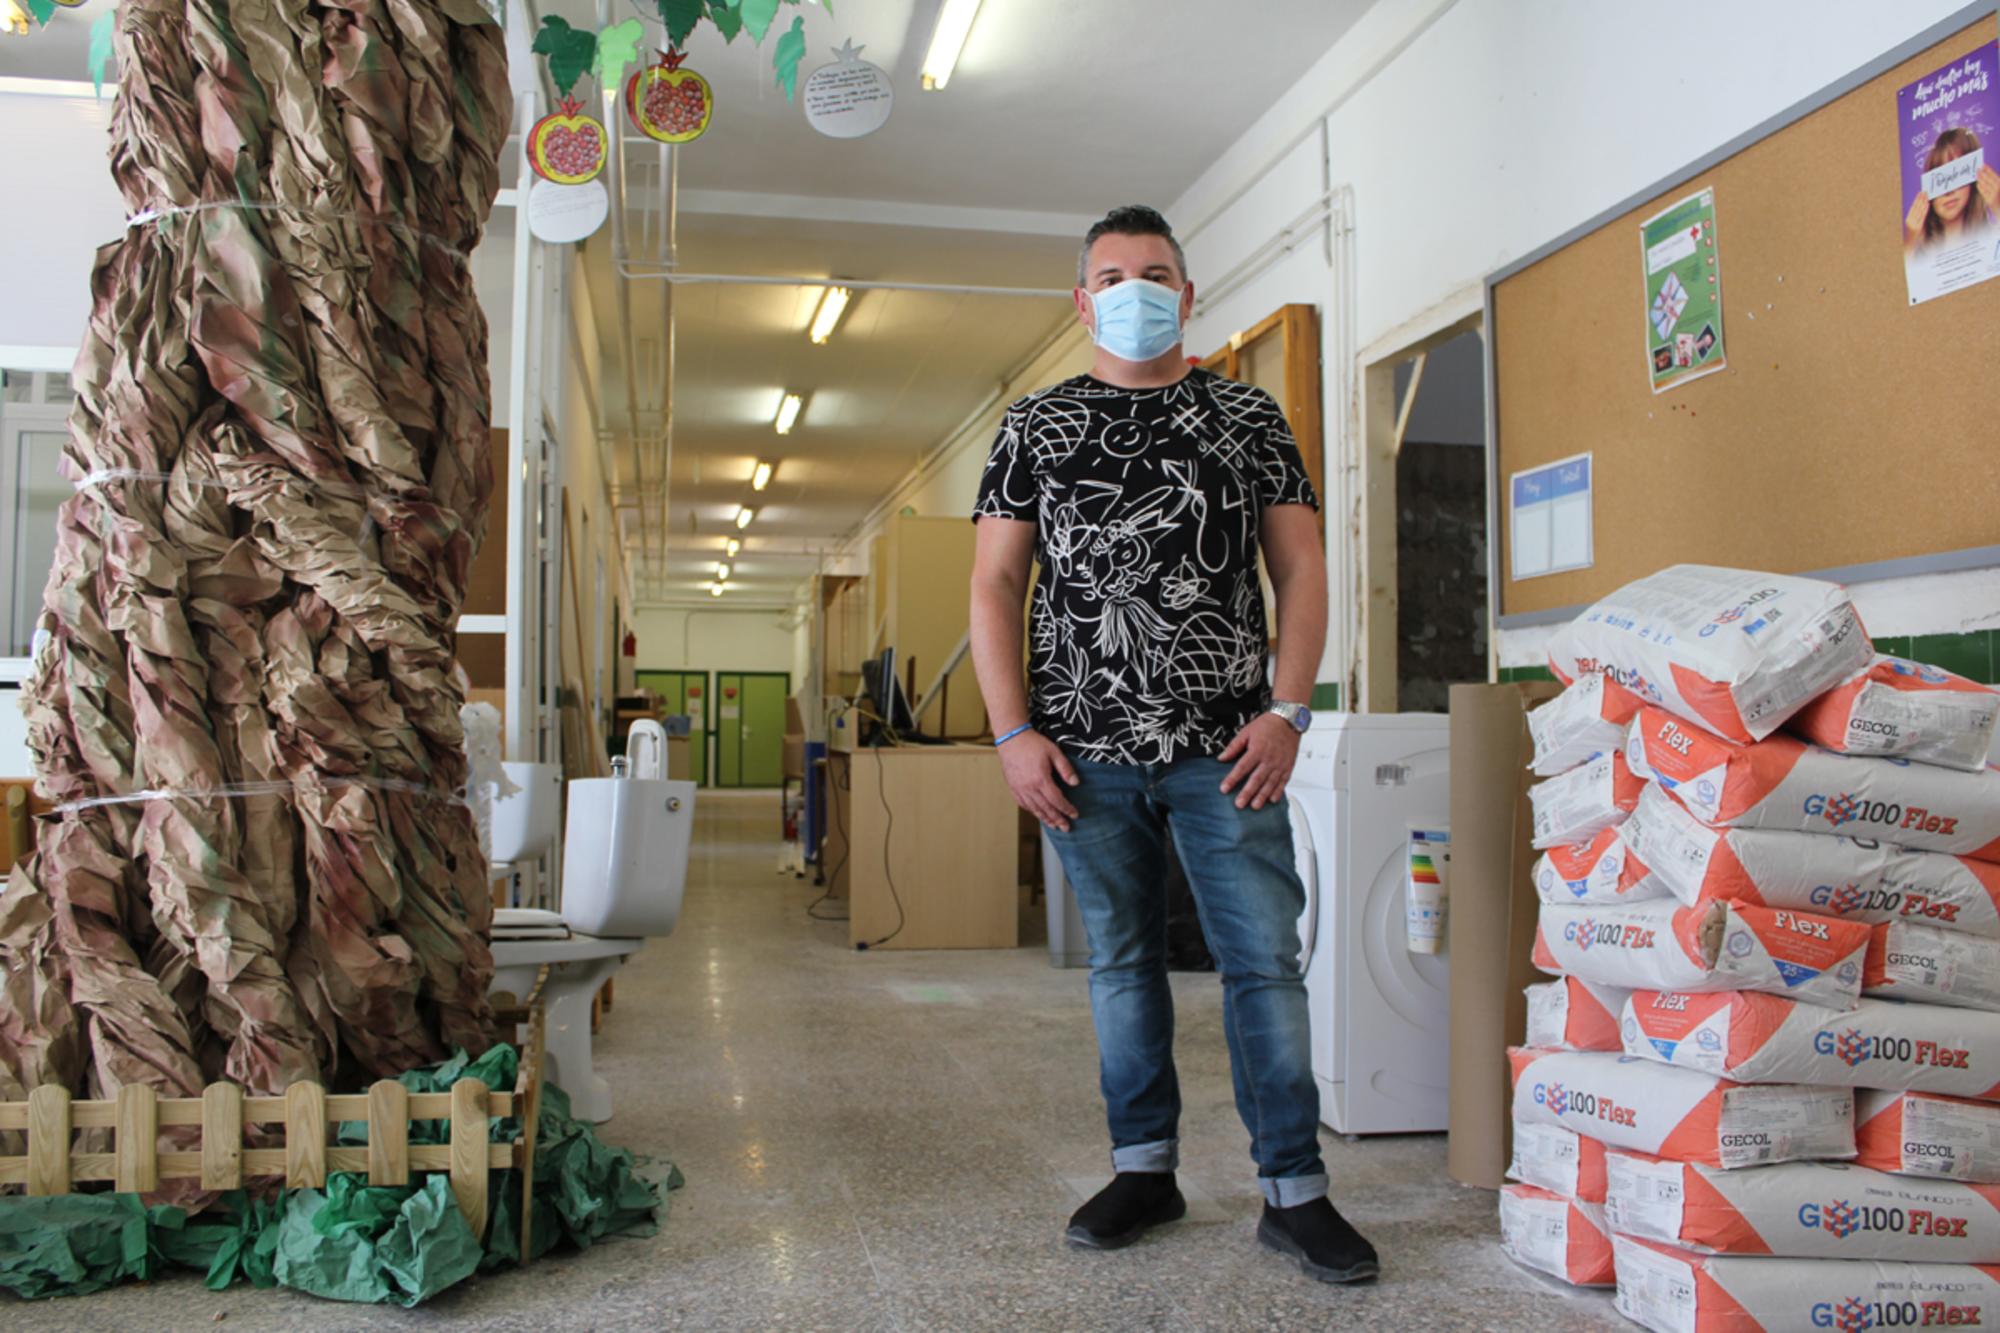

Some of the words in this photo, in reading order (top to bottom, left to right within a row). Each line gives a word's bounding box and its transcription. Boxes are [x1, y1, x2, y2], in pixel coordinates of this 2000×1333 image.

[1912, 88, 1956, 121] mucho
[1958, 71, 1988, 98] más
[1658, 720, 1693, 756] Flex
[1850, 718, 1899, 737] GECOL
[1858, 800, 1901, 825] 100
[1901, 806, 1958, 835] Flex
[1900, 894, 1960, 922] Flex
[1597, 924, 1621, 945] 100
[1775, 912, 1830, 941] Flex
[1887, 953, 1938, 971] GECOL
[1872, 1036, 1911, 1062] 100
[1914, 1040, 1969, 1068] Flex
[1569, 1090, 1596, 1115] 100
[1597, 1097, 1636, 1128] Flex
[1721, 1133, 1772, 1147] GECOL
[1904, 1142, 1955, 1159] GECOL
[1862, 1206, 1904, 1232] 100
[1908, 1210, 1968, 1238] Flex
[1874, 1301, 1917, 1327] 100
[1920, 1301, 1981, 1327] Flex
